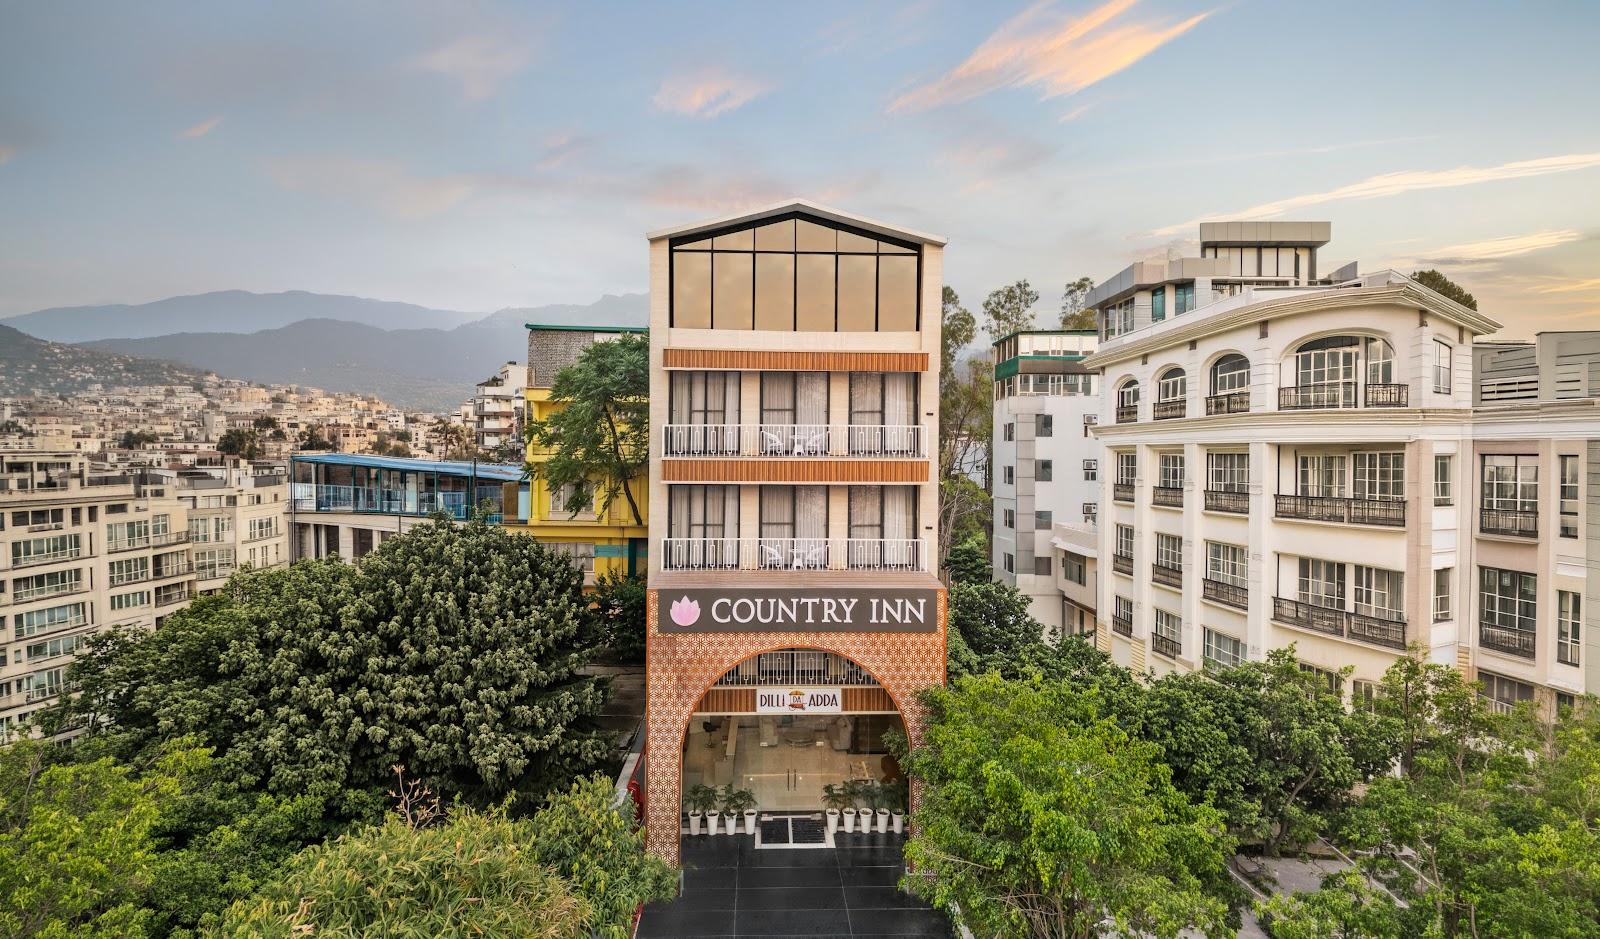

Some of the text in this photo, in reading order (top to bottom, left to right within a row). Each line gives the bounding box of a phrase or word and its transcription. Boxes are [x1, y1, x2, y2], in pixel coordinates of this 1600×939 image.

[711, 598, 926, 624] COUNTRY INN
[760, 693, 838, 707] DILLI DA ADDA
